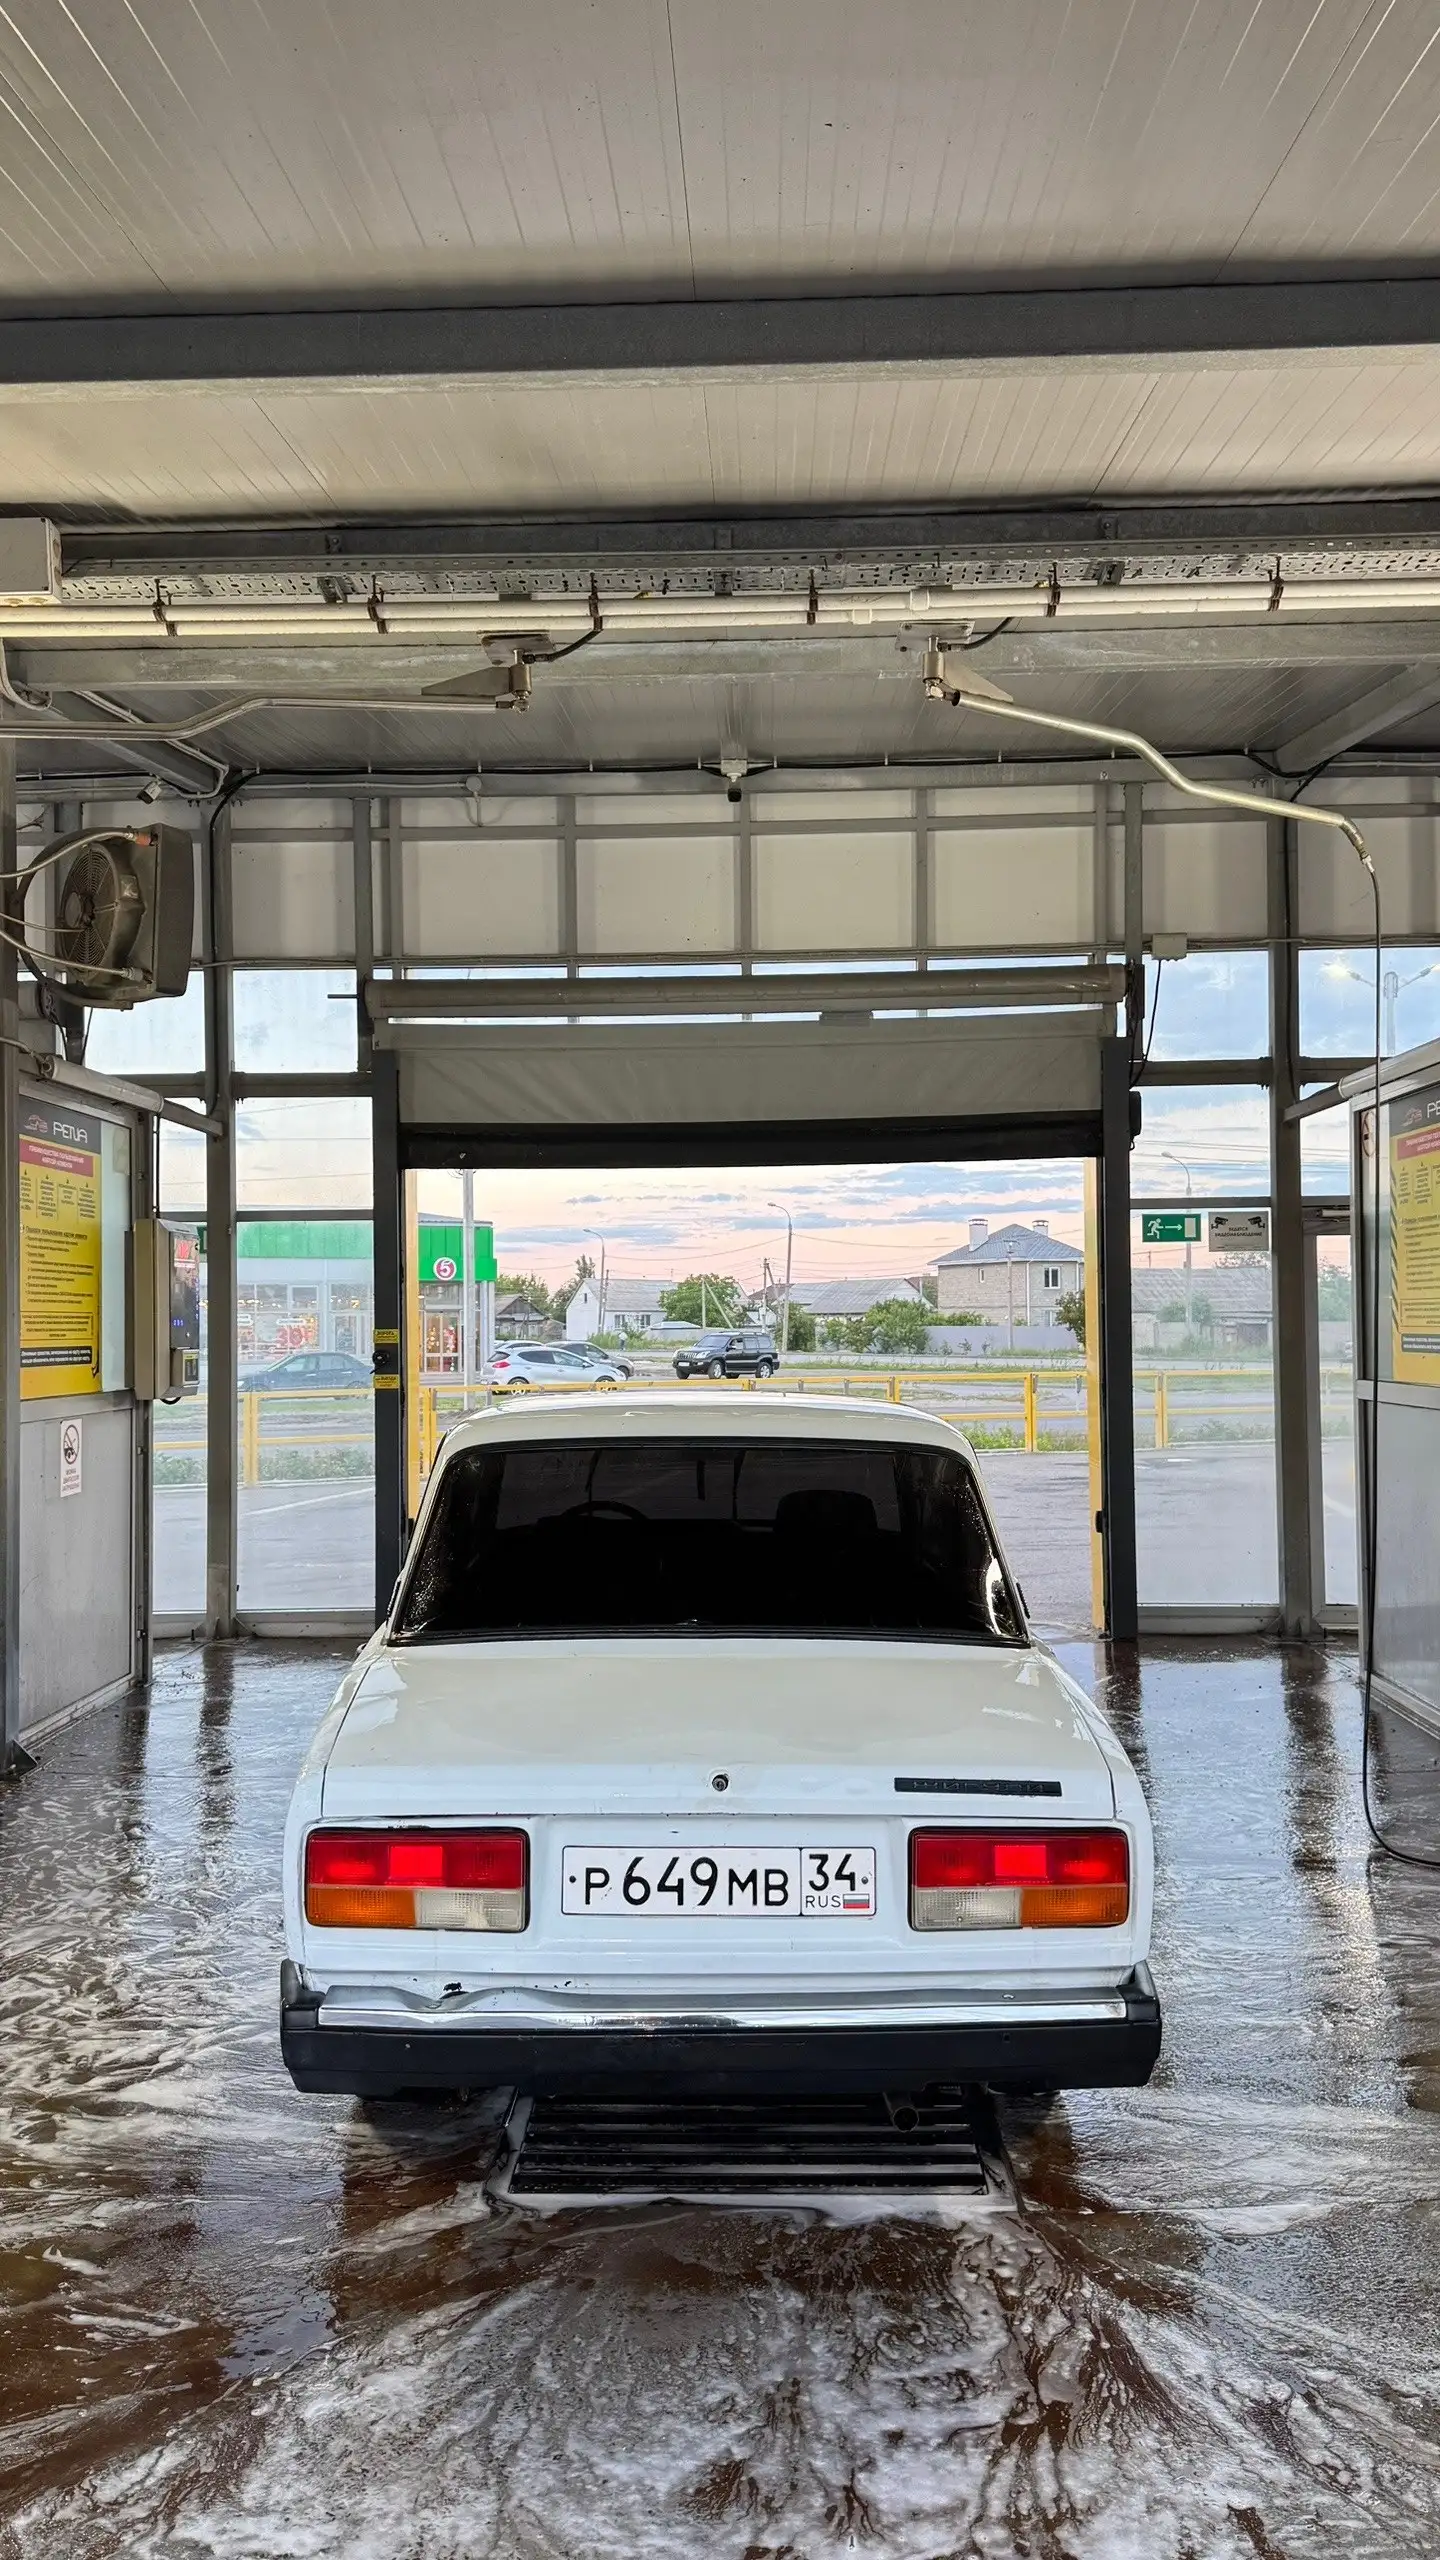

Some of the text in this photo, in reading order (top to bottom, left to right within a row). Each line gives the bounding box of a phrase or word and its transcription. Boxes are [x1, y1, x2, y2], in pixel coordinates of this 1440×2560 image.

[584, 1853, 856, 1906] Р649МВ 34
[805, 1895, 842, 1909] RUS
